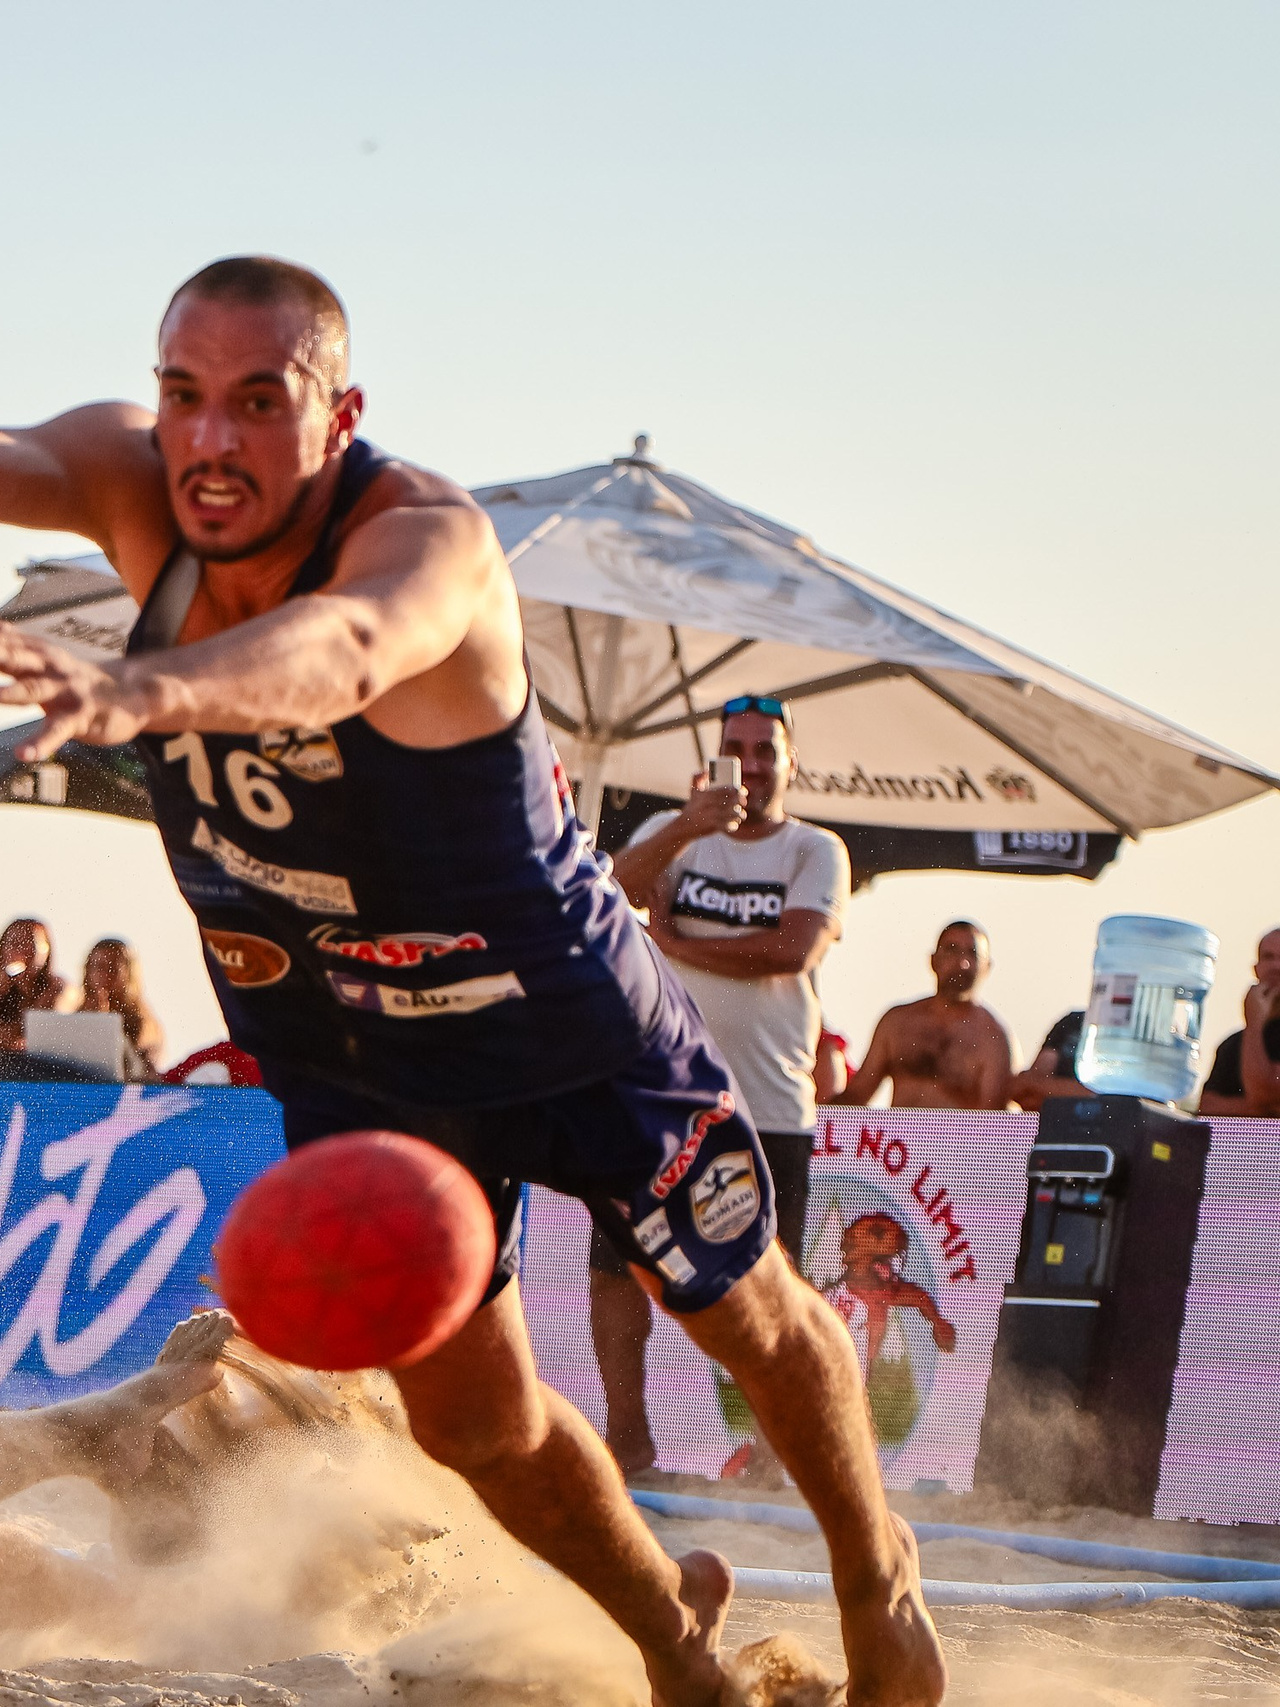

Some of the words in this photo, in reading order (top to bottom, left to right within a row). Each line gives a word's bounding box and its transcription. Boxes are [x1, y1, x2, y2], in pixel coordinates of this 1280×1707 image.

[164, 731, 294, 830] 16
[856, 1124, 908, 1177] NO
[910, 1165, 976, 1284] LIMIT
